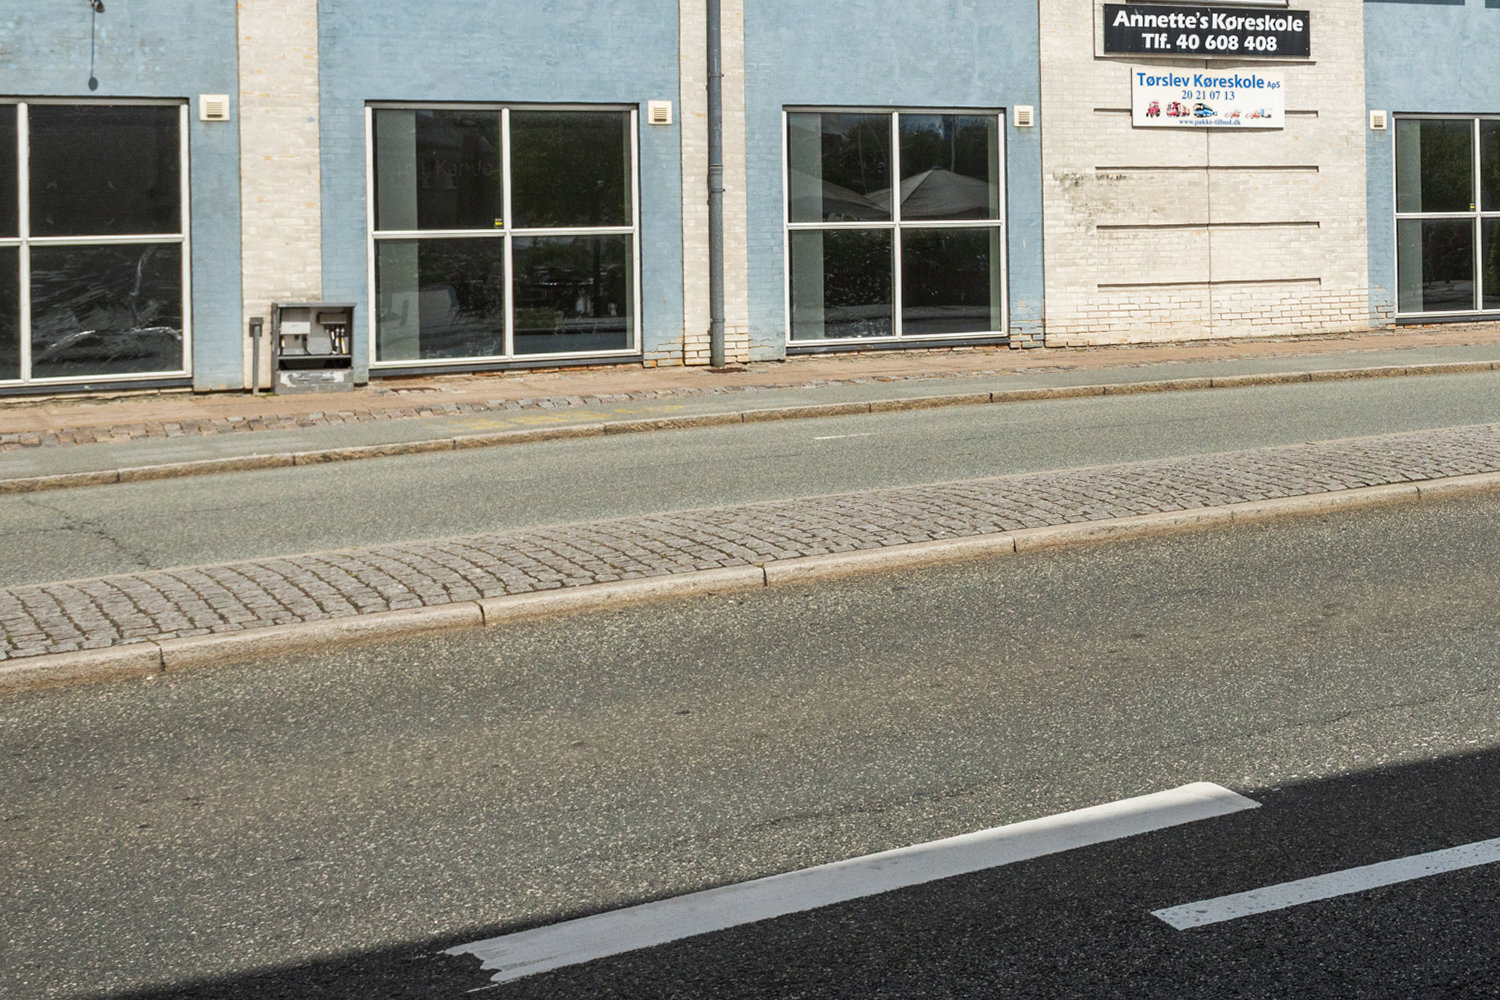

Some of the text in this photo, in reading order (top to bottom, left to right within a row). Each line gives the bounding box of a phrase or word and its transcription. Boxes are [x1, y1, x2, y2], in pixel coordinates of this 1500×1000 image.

[1113, 10, 1304, 32] Annette's Køreskole
[1142, 33, 1278, 51] Tlf. 40 608 408
[1136, 72, 1190, 87] Tørslev
[1193, 73, 1265, 89] Køreskole
[1182, 90, 1235, 101] 20 21 07 13
